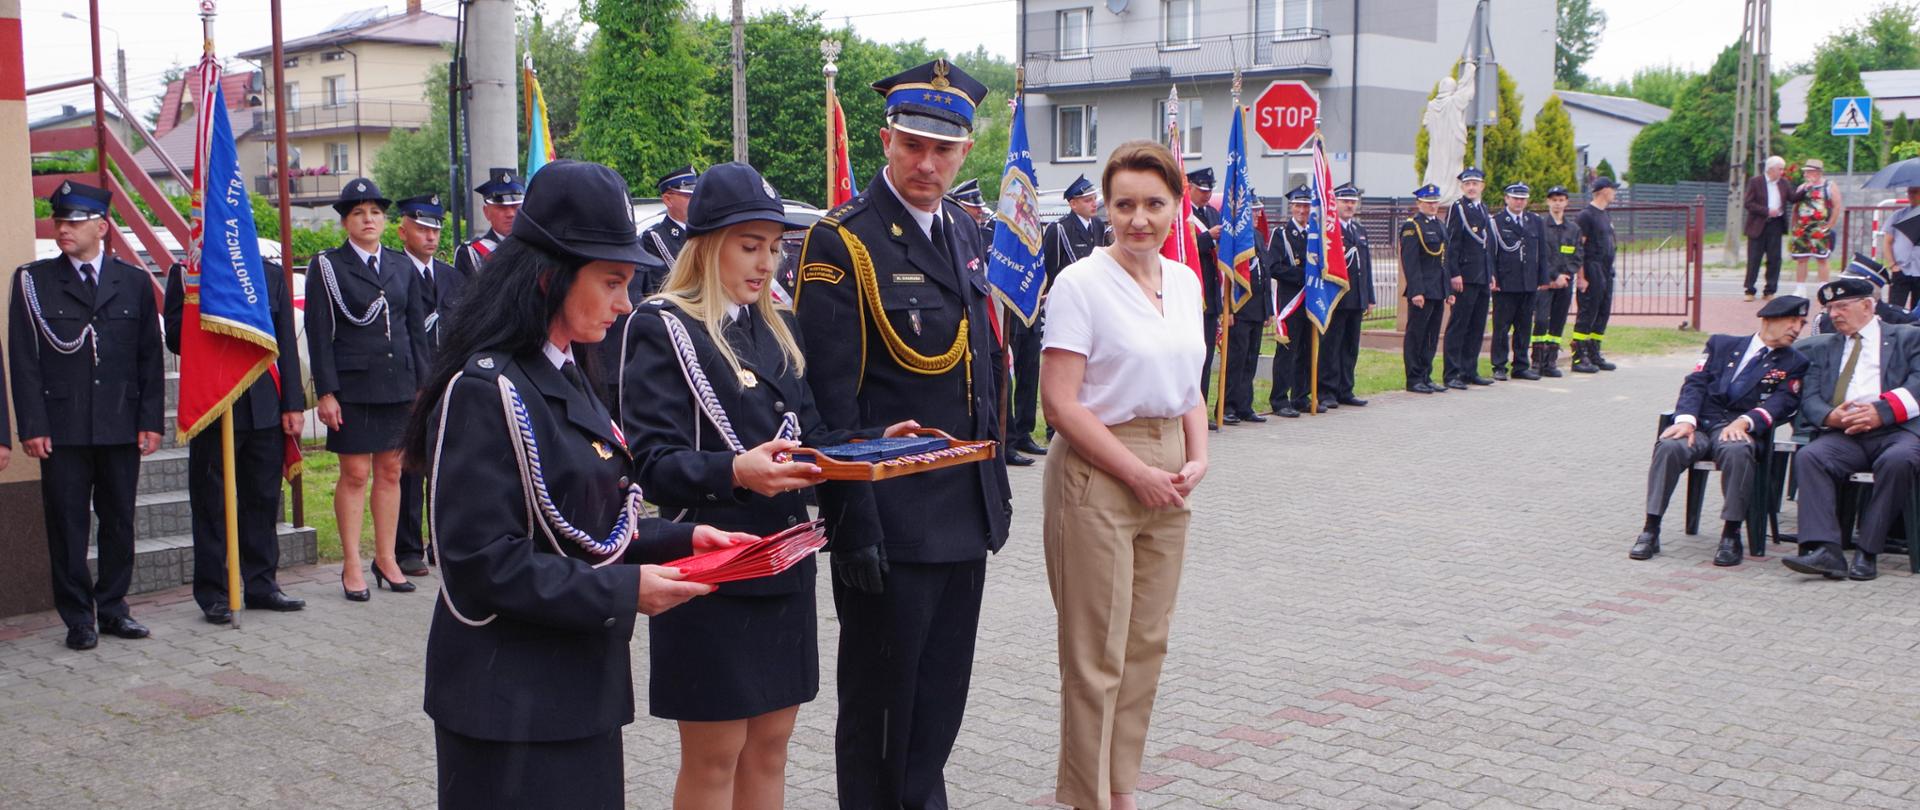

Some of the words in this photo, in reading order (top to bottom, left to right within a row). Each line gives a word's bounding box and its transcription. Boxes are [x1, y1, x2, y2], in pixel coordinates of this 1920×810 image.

[1261, 106, 1312, 128] STOP
[226, 217, 258, 304] OCHOTNICZA
[991, 248, 1025, 273] ZWIĄZEK
[1019, 270, 1034, 293] 1949
